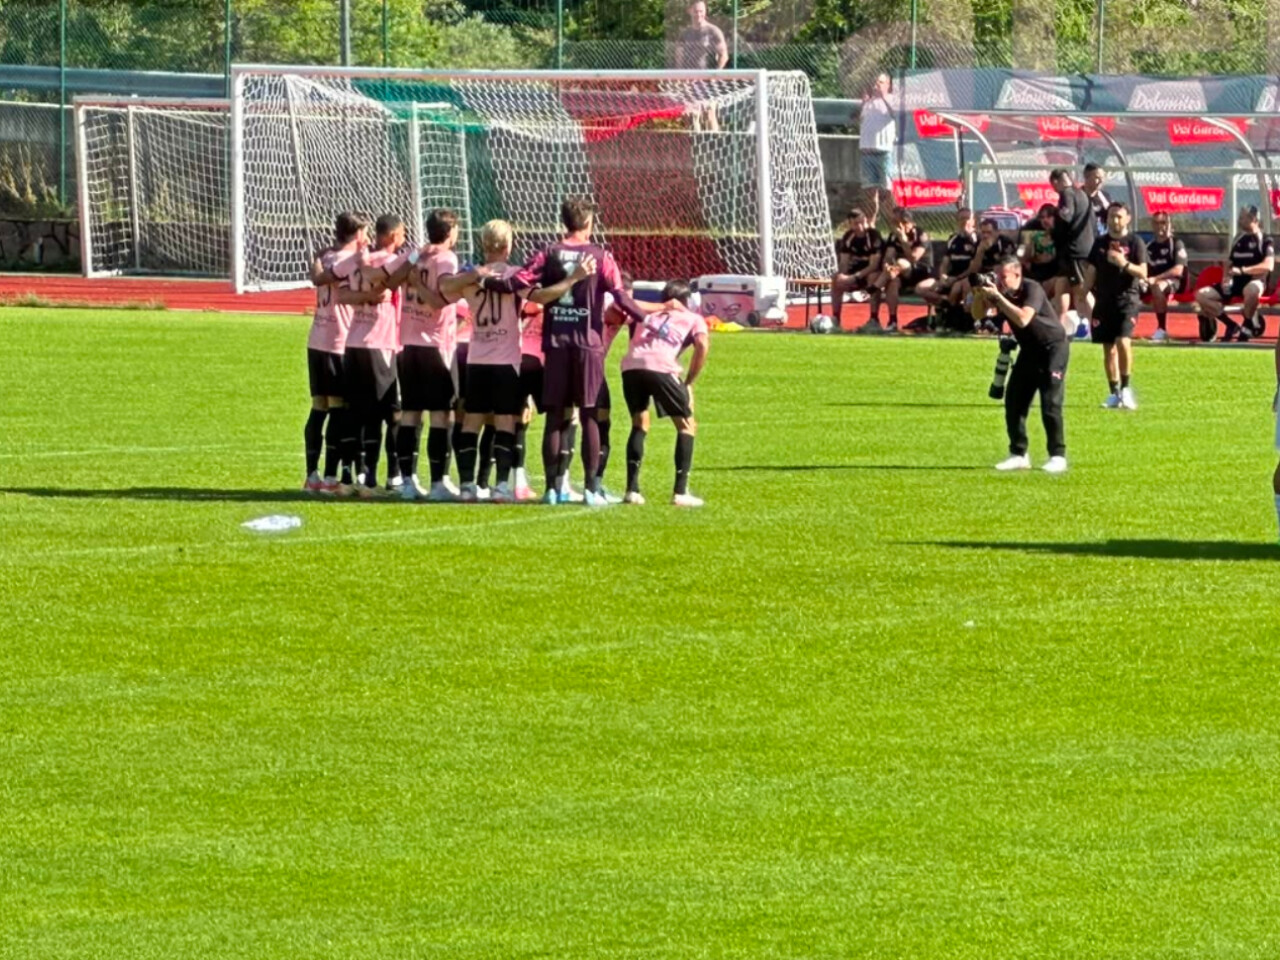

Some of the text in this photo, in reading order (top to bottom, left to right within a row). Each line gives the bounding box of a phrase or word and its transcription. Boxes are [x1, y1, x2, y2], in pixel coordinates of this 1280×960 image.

[1133, 90, 1201, 111] Dolomites
[1149, 191, 1216, 205] Val Gardena
